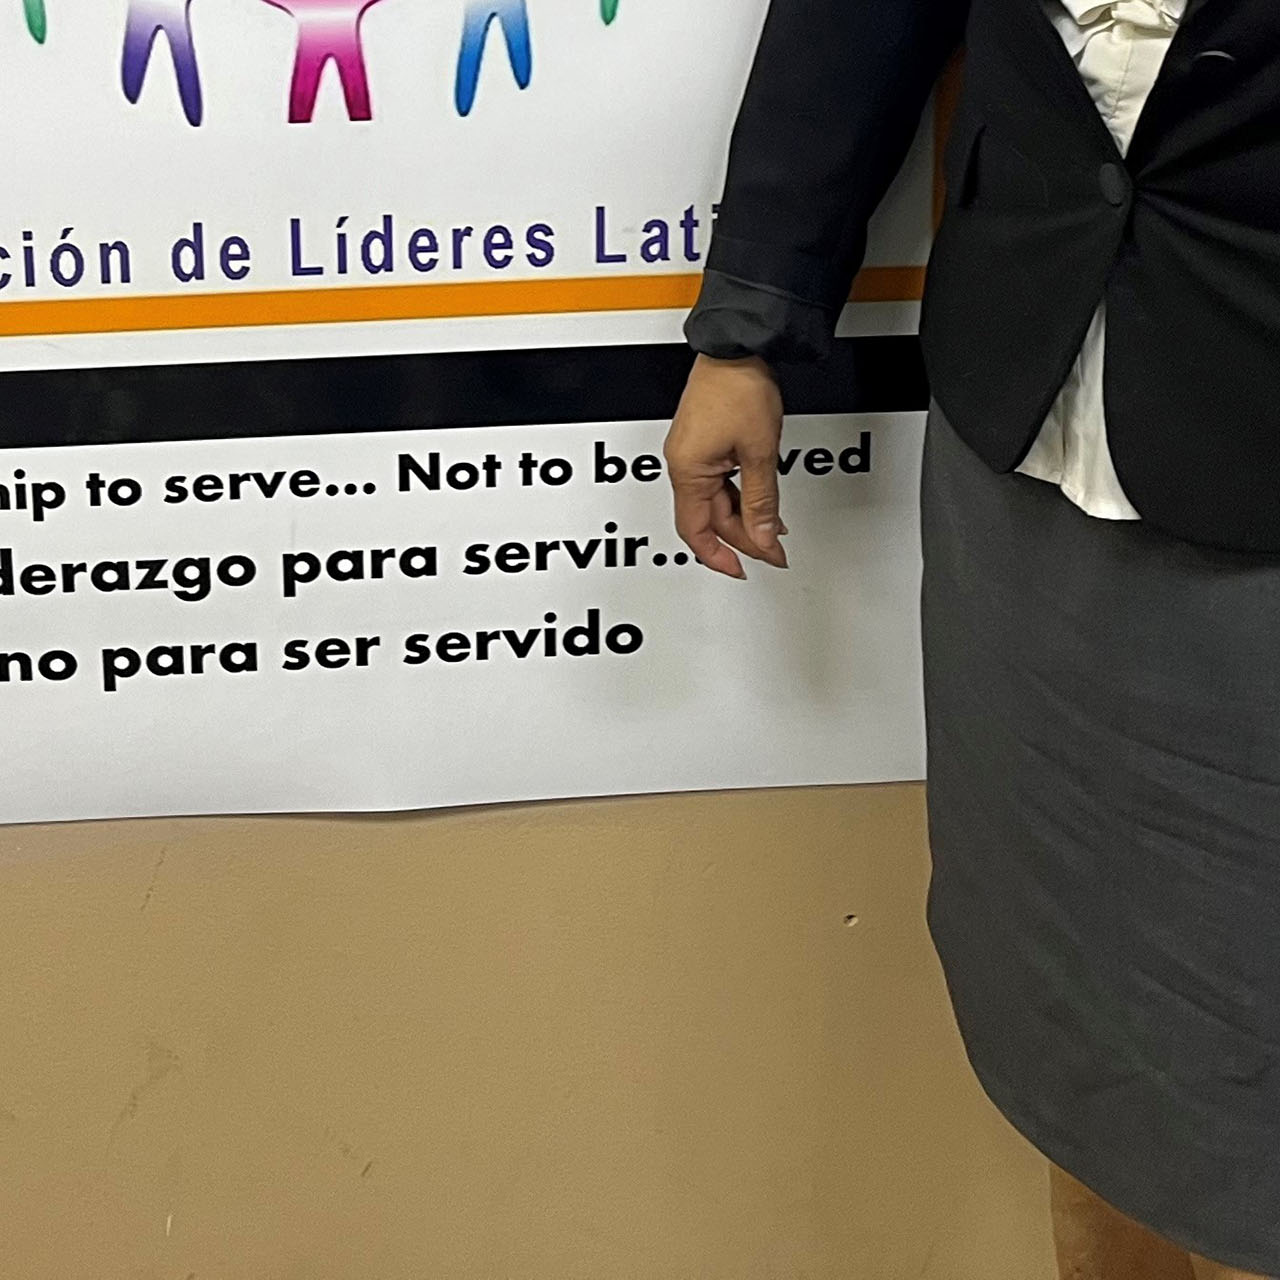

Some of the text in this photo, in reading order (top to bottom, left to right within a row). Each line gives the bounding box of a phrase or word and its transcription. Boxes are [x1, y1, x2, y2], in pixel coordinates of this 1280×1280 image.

[172, 222, 250, 282] de
[290, 215, 555, 276] Líderes
[594, 205, 720, 264] Lat
[86, 473, 142, 506] to
[164, 470, 376, 503] serve...
[398, 452, 502, 492] Not
[519, 453, 573, 486] to
[594, 441, 662, 484] be
[283, 547, 437, 597] para
[102, 643, 257, 692] para
[282, 636, 380, 670] ser
[403, 608, 643, 664] servido
